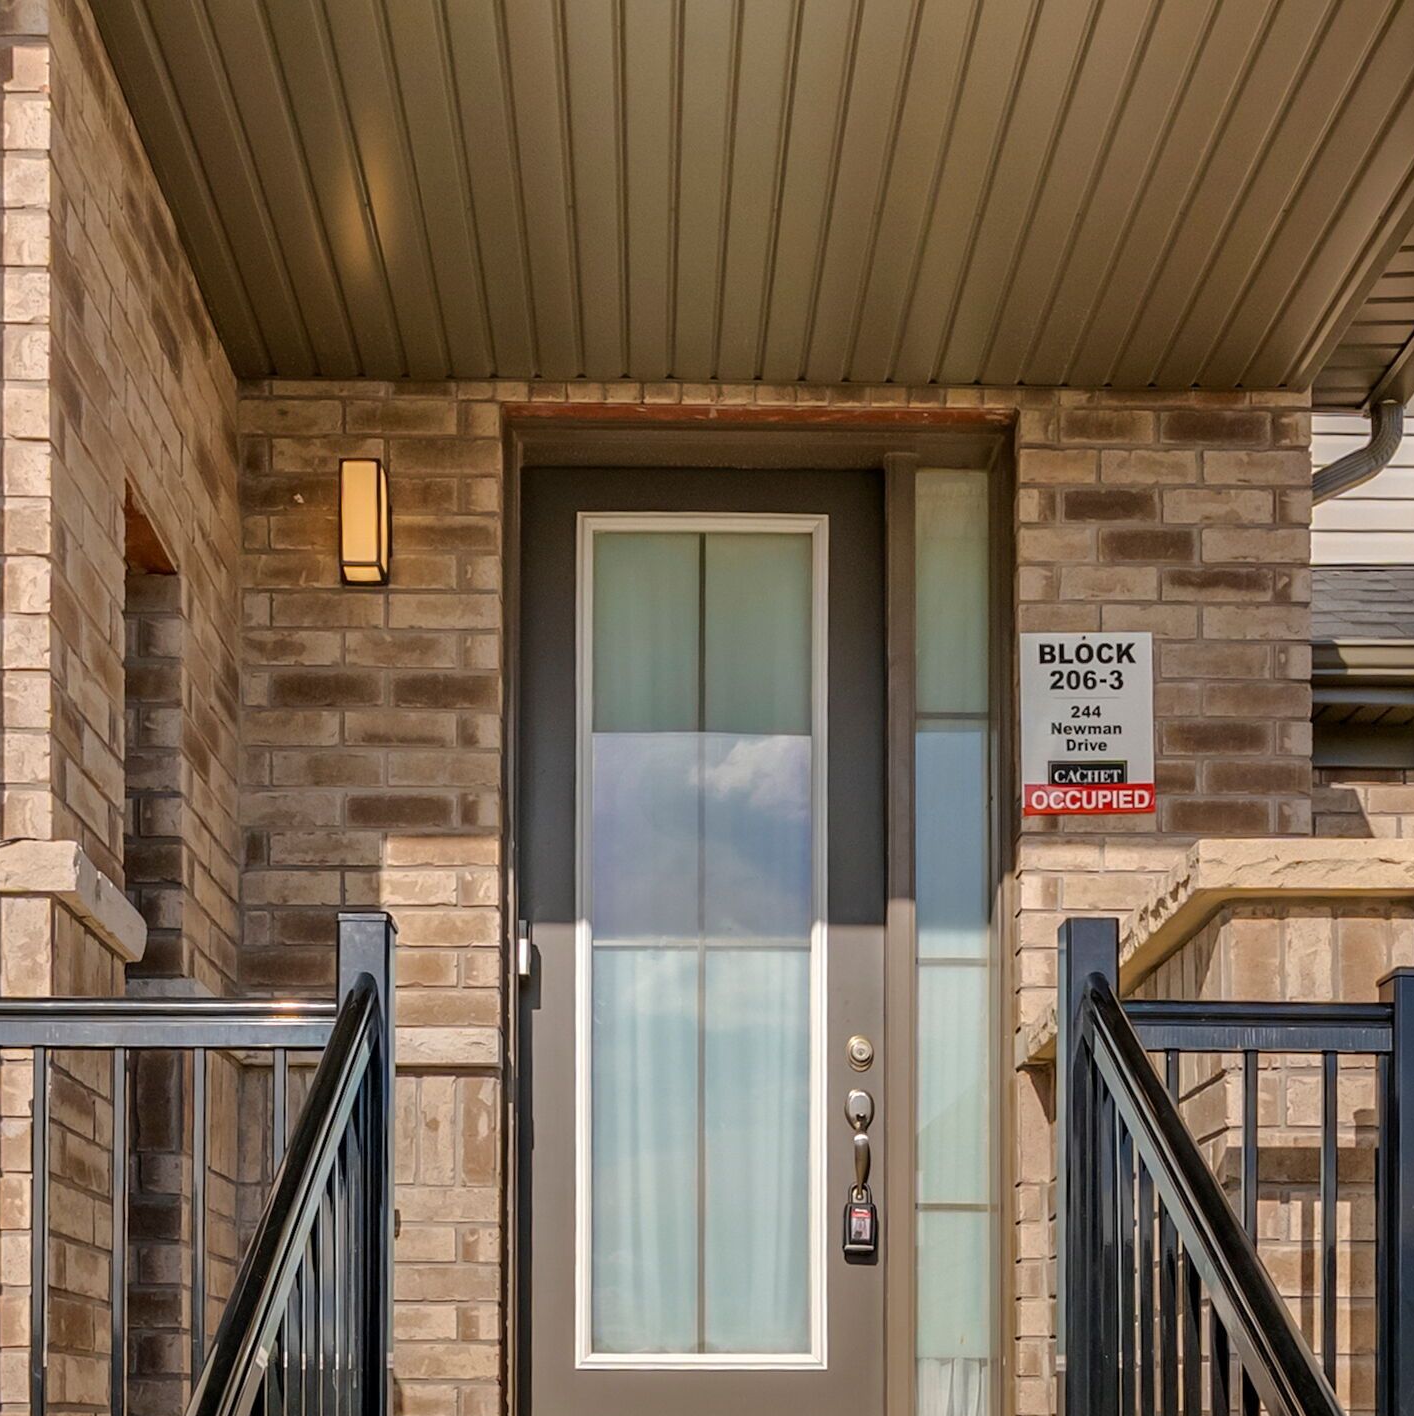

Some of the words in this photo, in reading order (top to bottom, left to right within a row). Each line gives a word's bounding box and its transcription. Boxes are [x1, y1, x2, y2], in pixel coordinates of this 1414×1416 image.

[1039, 643, 1136, 664] BLOCK
[1049, 670, 1124, 690] 206-3
[1070, 705, 1102, 718] 244
[1051, 722, 1123, 735] Newman
[1066, 739, 1108, 751] Drive
[1054, 767, 1122, 783] CACHET
[1031, 790, 1150, 810] OCCUPIED
